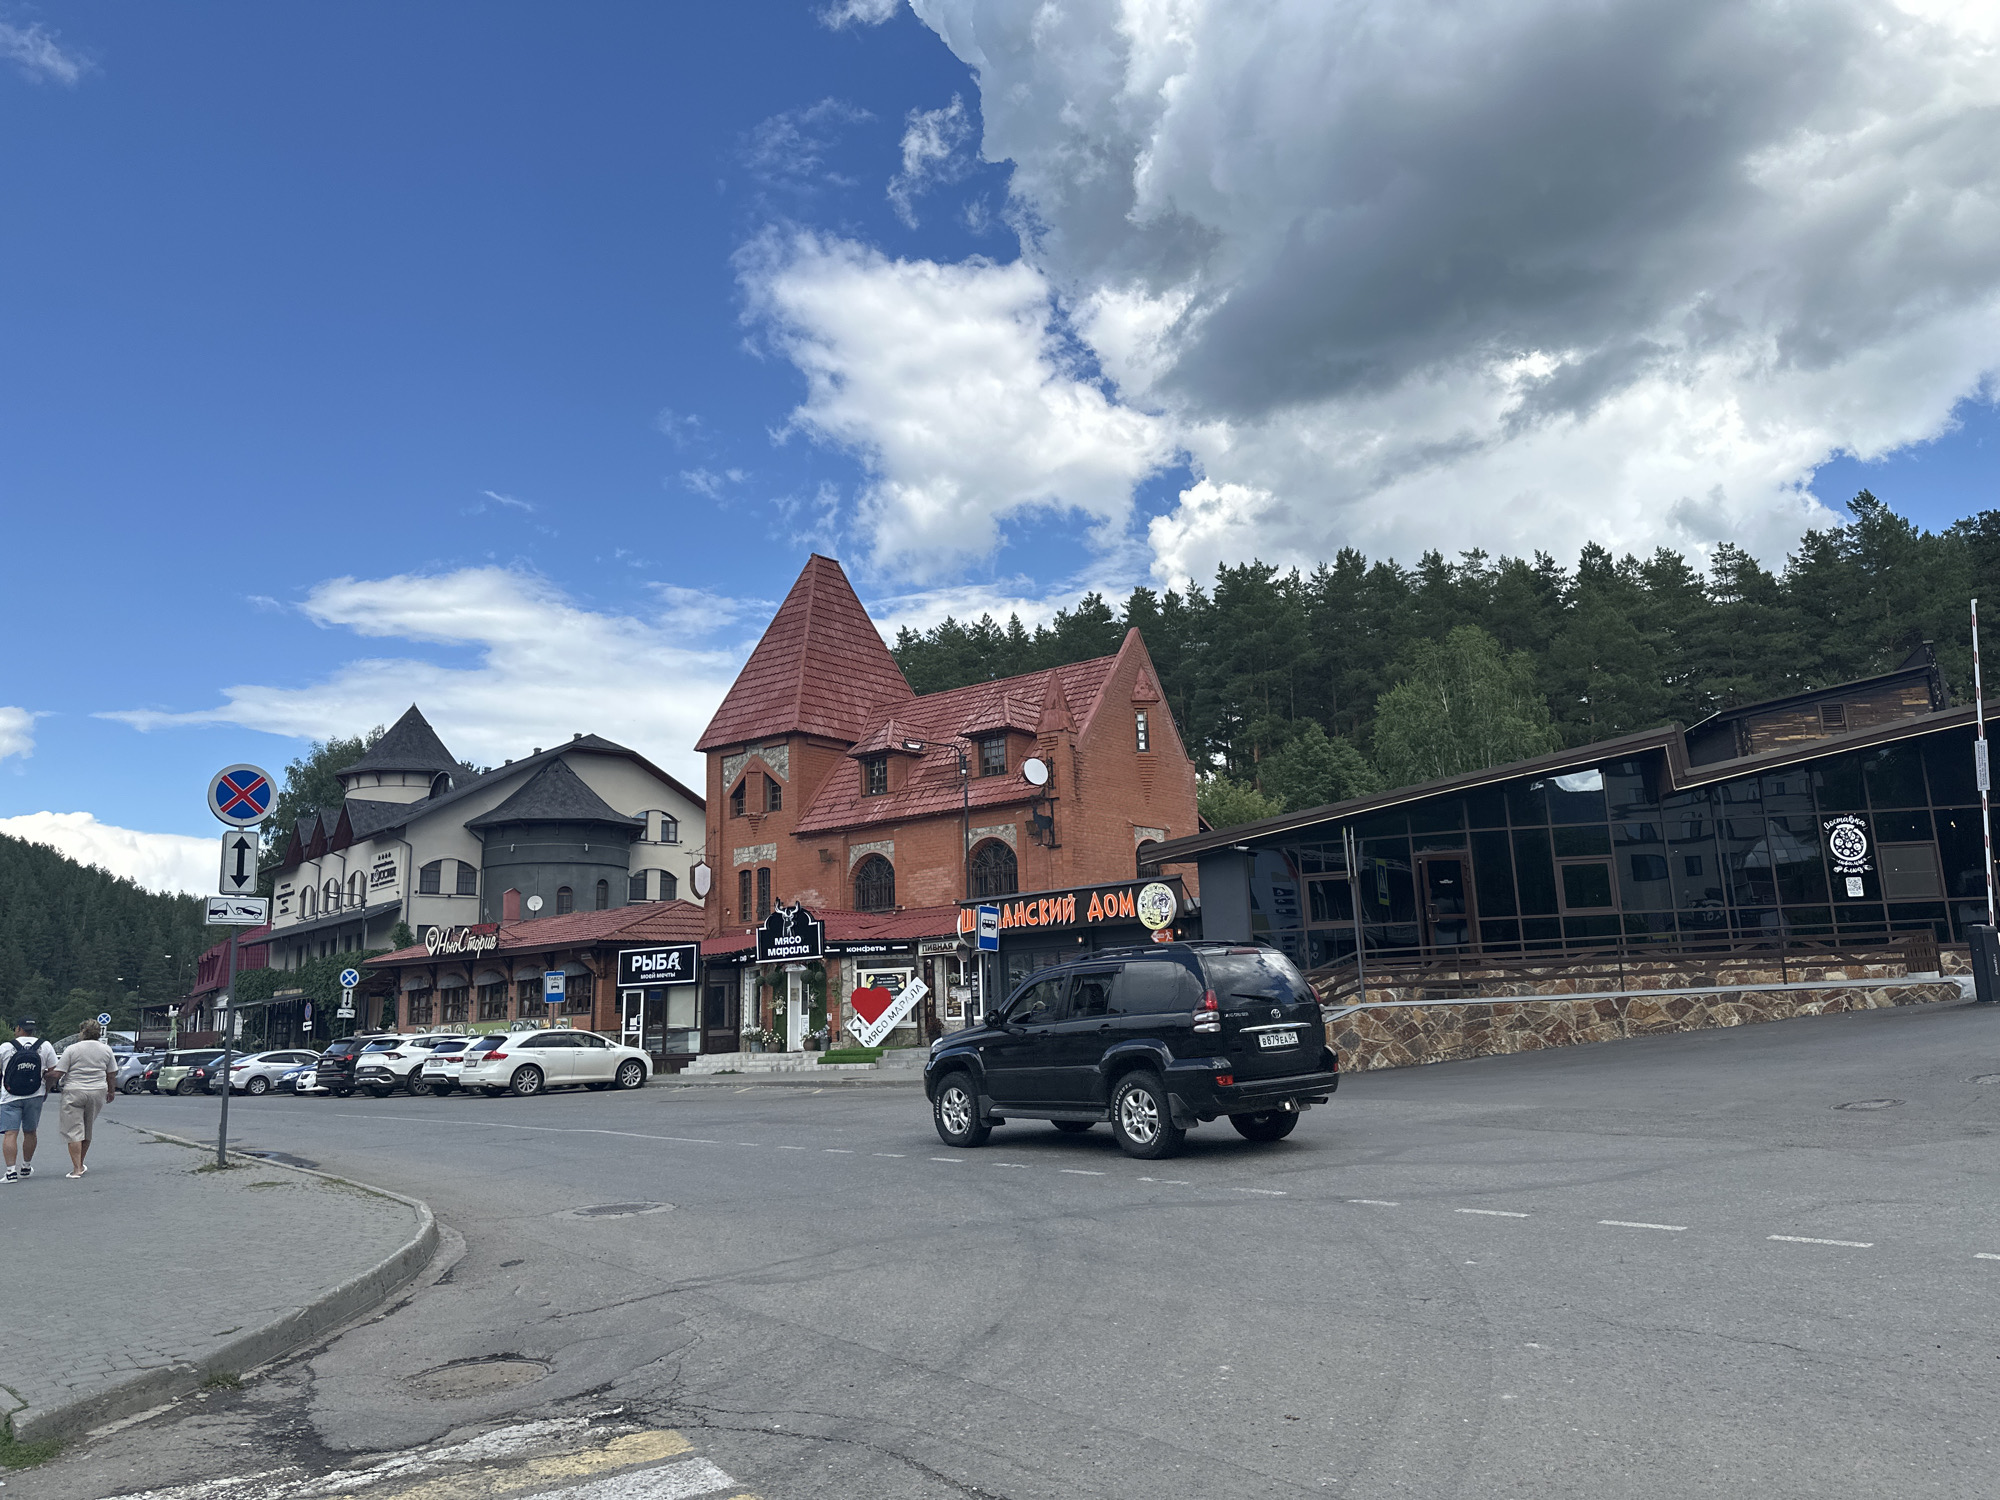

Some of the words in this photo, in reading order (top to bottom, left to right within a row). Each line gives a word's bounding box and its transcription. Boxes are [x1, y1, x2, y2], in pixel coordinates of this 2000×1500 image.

[960, 893, 1076, 934] ШАНСКИЙ
[1087, 887, 1136, 923] ДОМ
[774, 935, 802, 946] мясо
[767, 945, 810, 957] марала
[846, 944, 887, 953] конфеты
[922, 943, 954, 952] ПИВНАЯ
[631, 951, 682, 972] РЫБА
[640, 972, 656, 980] моей
[864, 1020, 889, 1046] МЯСО
[887, 984, 924, 1021] МАРАЛА
[850, 1016, 869, 1038] Я
